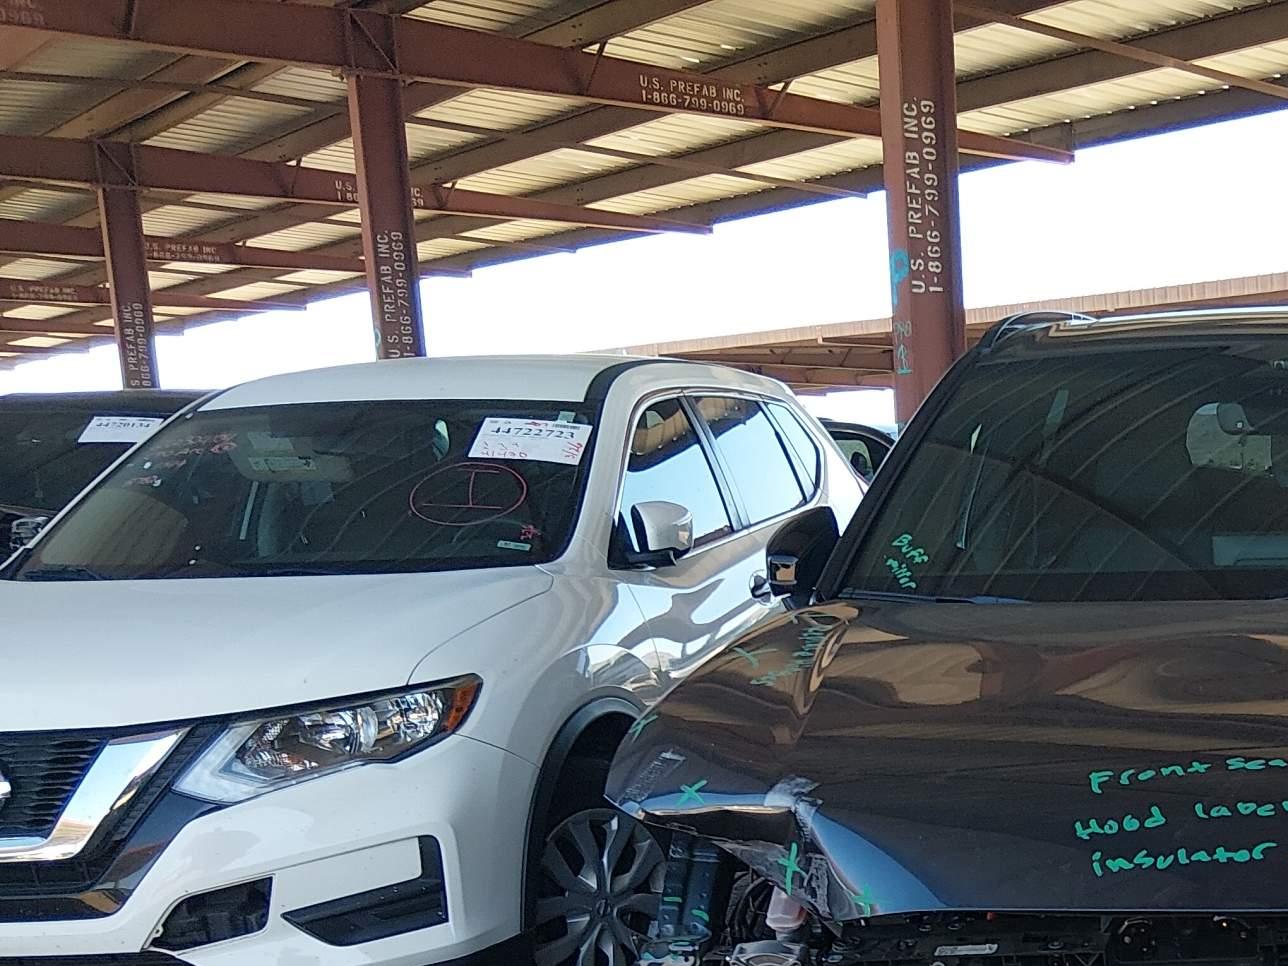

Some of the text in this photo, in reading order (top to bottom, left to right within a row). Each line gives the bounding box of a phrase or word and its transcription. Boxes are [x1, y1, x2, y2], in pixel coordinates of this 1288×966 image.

[639, 74, 745, 102] U.S. PREFAB INC.
[641, 89, 745, 115] 1-866-799-0969
[902, 96, 926, 294] U.S. PREFAB INC.
[919, 99, 944, 293] 1-866-799-0969
[376, 229, 390, 257] INC.
[381, 265, 397, 322] PREFAB
[127, 328, 139, 371] PREFAB
[491, 426, 576, 439] 44722723
